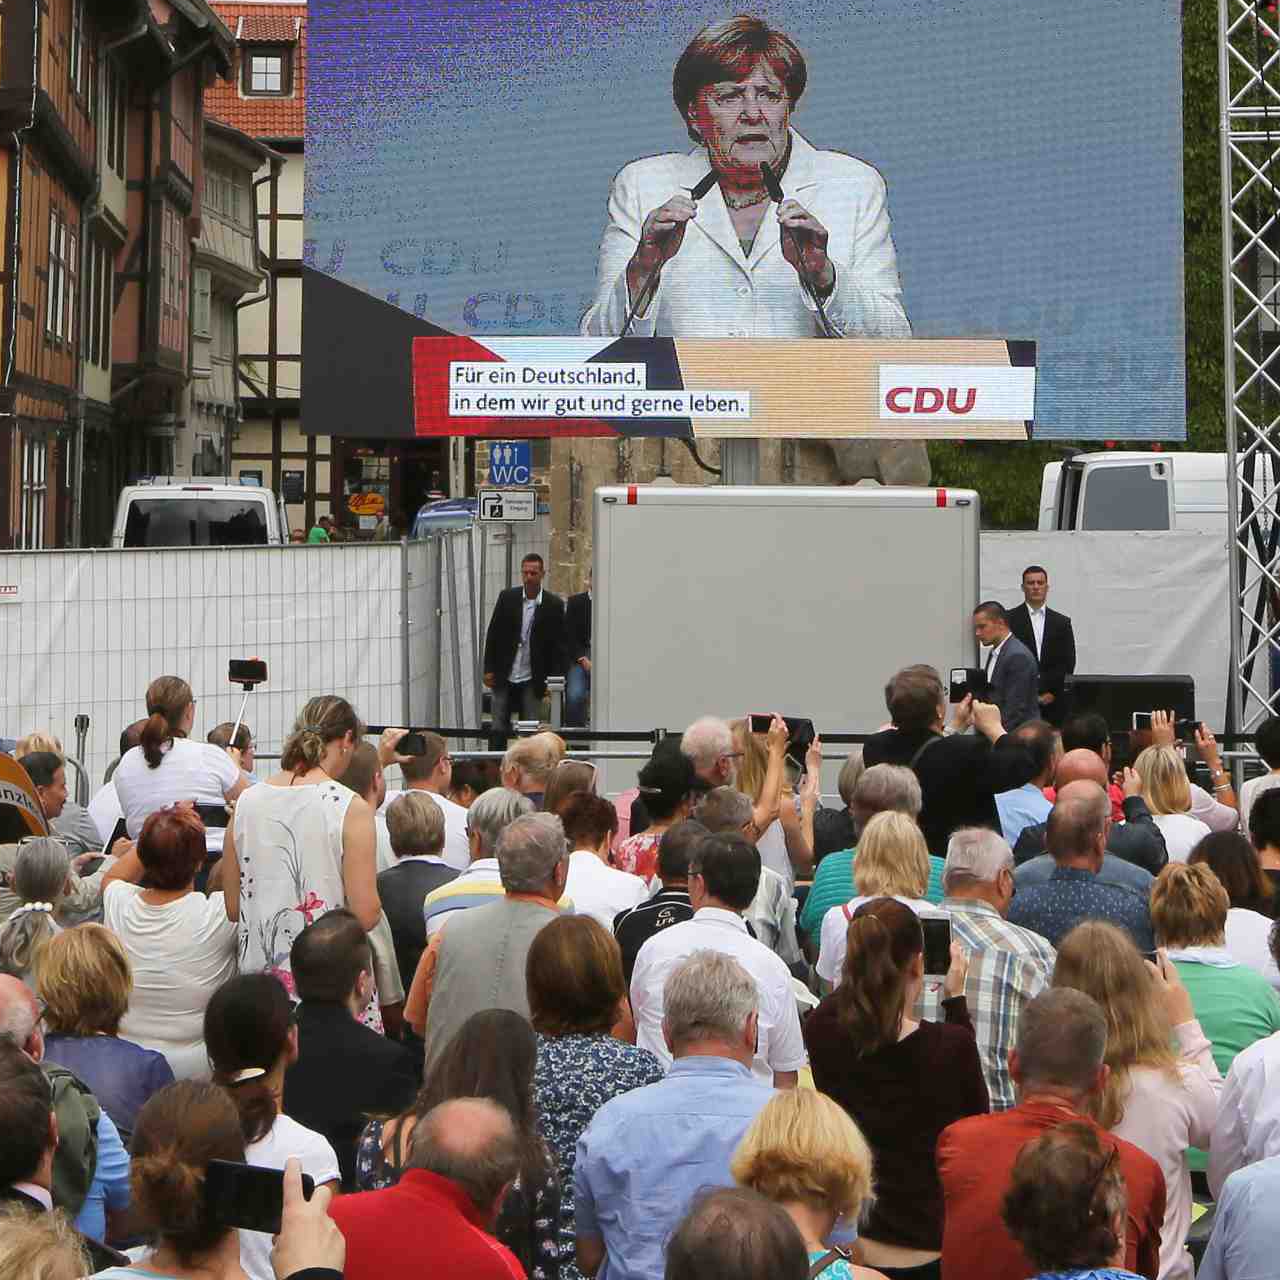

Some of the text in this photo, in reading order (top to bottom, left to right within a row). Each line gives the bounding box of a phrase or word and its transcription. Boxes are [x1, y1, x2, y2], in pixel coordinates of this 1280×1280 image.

[455, 366, 642, 387] Für ein Deutschland,
[454, 393, 746, 417] in dem wir gut und gerne leben.
[885, 387, 977, 415] CDU
[492, 465, 529, 484] WC
